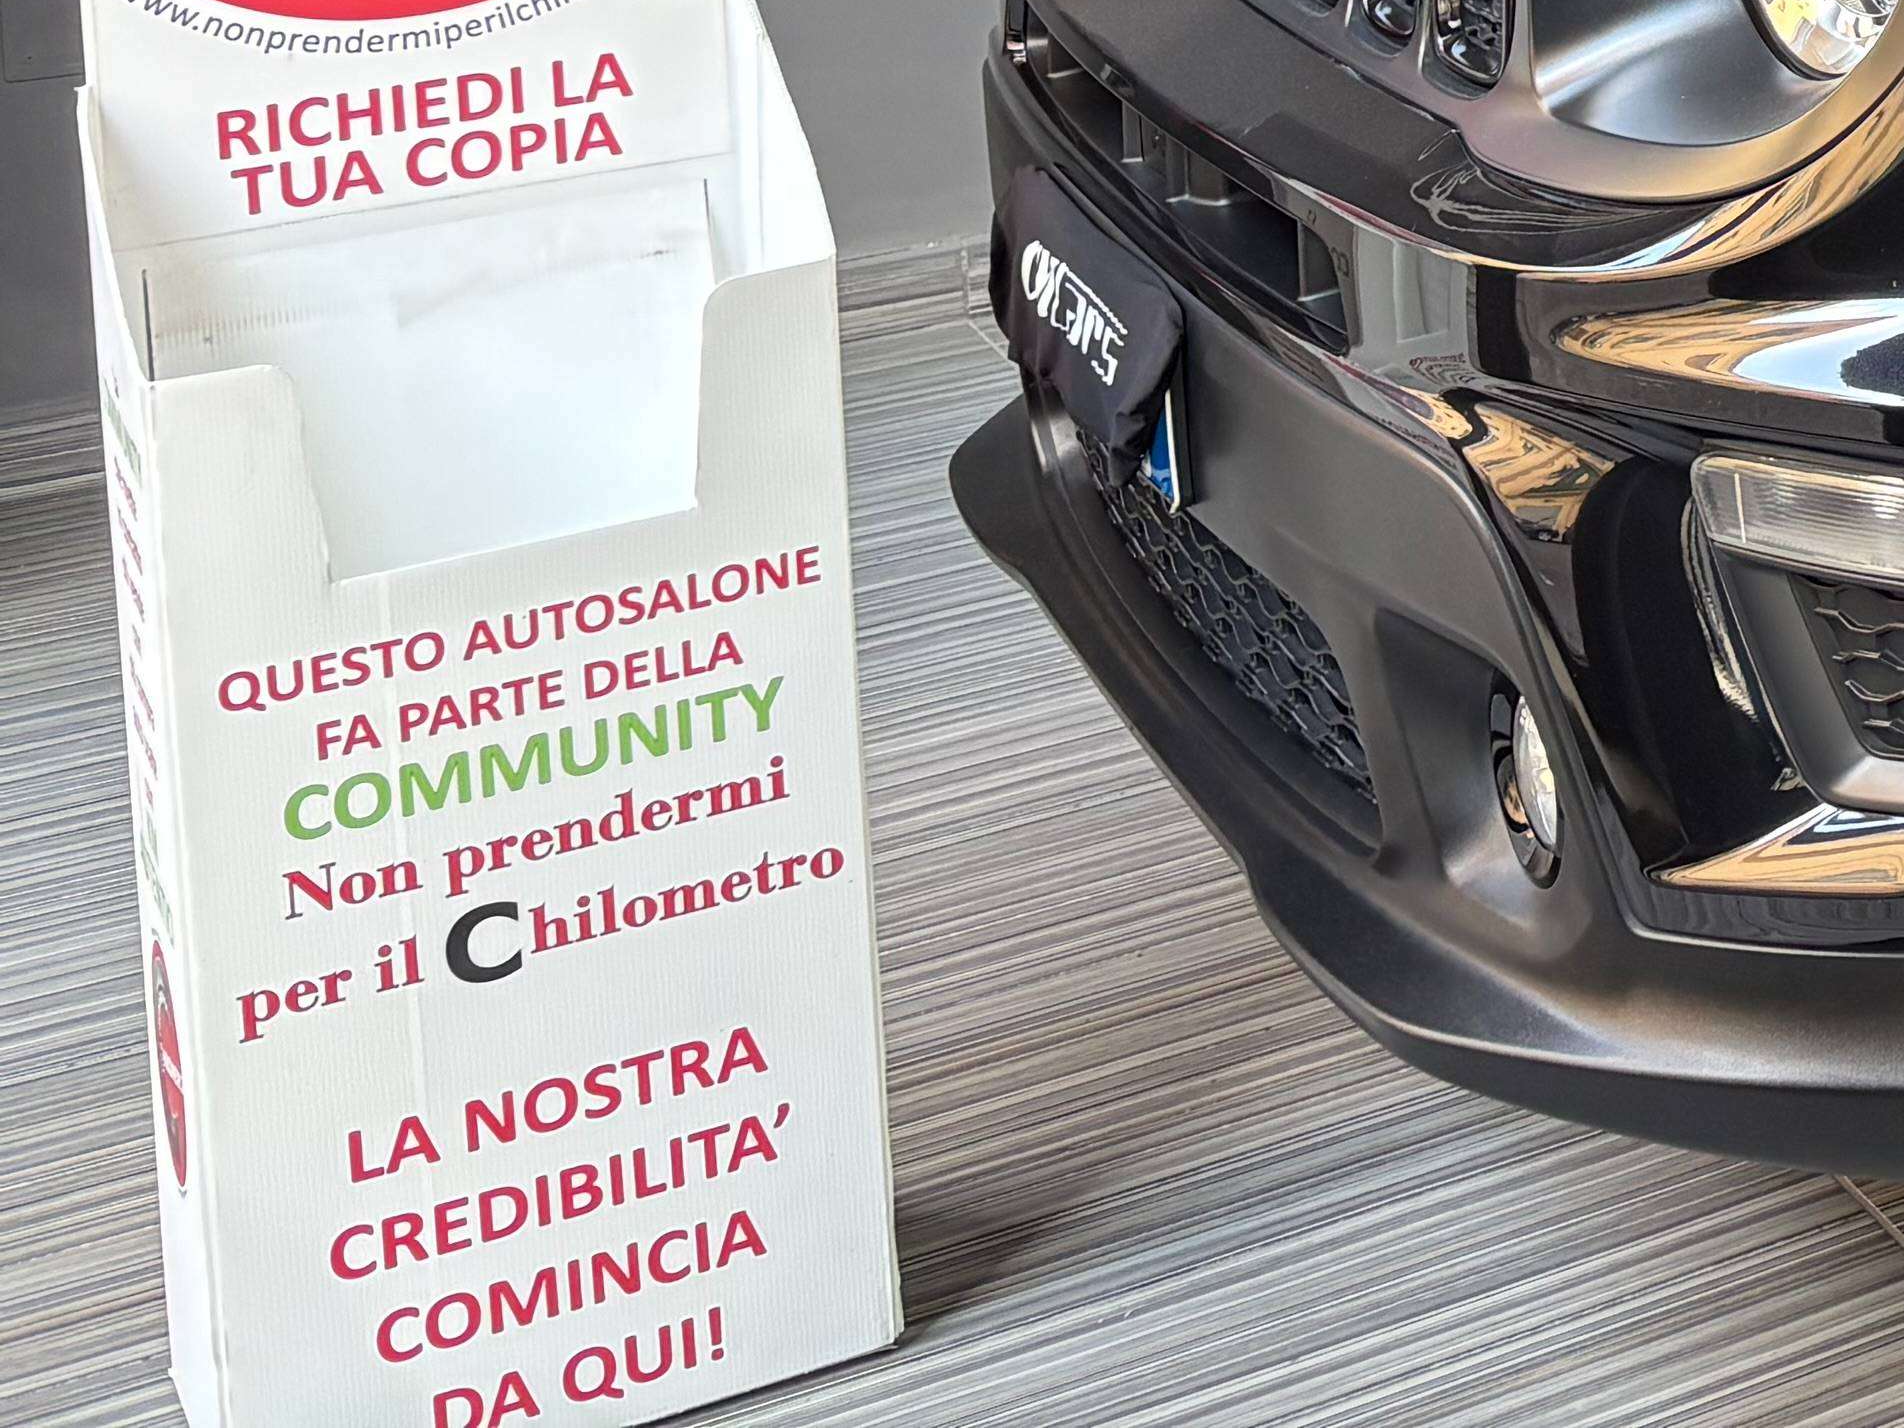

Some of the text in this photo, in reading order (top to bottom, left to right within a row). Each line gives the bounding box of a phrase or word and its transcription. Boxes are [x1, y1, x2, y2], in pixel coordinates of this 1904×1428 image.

[215, 52, 634, 161] RICHIEDI LA
[230, 111, 624, 216] TUA COPIA
[217, 631, 447, 716] QUESTO
[461, 545, 823, 662] AUTOSALONE
[316, 631, 744, 760] FA PARTE DELLA
[283, 676, 786, 842] COMMUNITY
[282, 861, 424, 921] Non
[442, 755, 790, 898] prendermi
[236, 844, 845, 1044] per il Chilometro
[347, 1025, 770, 1183] LA NOSTRA
[375, 1208, 768, 1365] COMINCIA
[431, 1306, 726, 1428] DA QUI!
